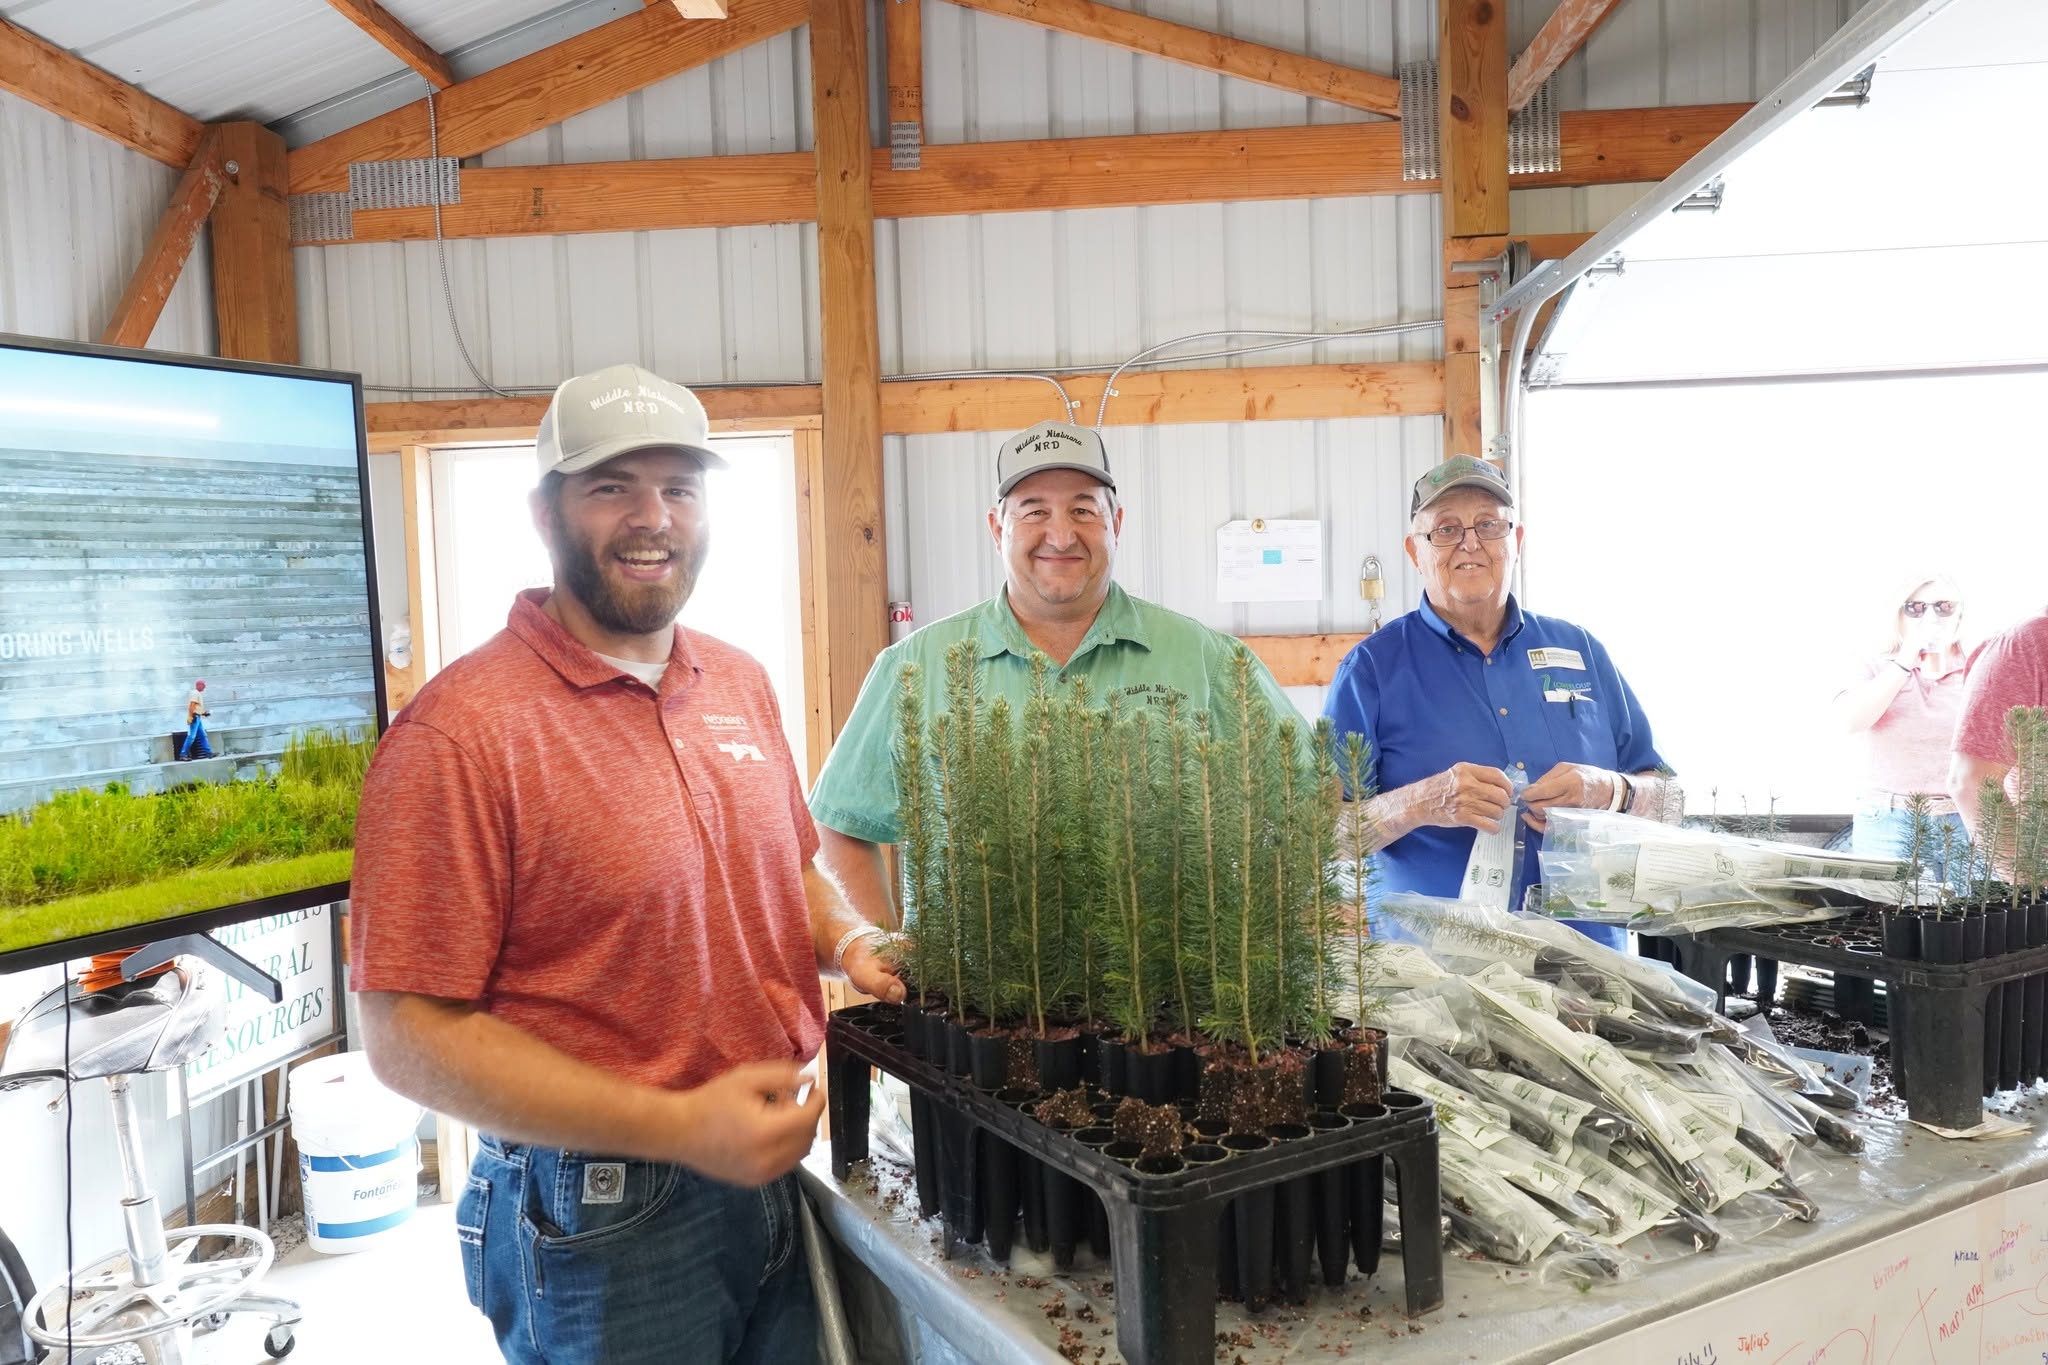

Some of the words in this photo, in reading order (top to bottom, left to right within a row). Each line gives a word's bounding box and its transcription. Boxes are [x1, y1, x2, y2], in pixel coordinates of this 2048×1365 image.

[590, 388, 630, 410] Middle
[623, 400, 659, 414] NRD
[1014, 434, 1041, 455] Middle
[1034, 440, 1060, 452] NRD
[0, 631, 73, 659] ORING
[79, 626, 155, 653] WELLS
